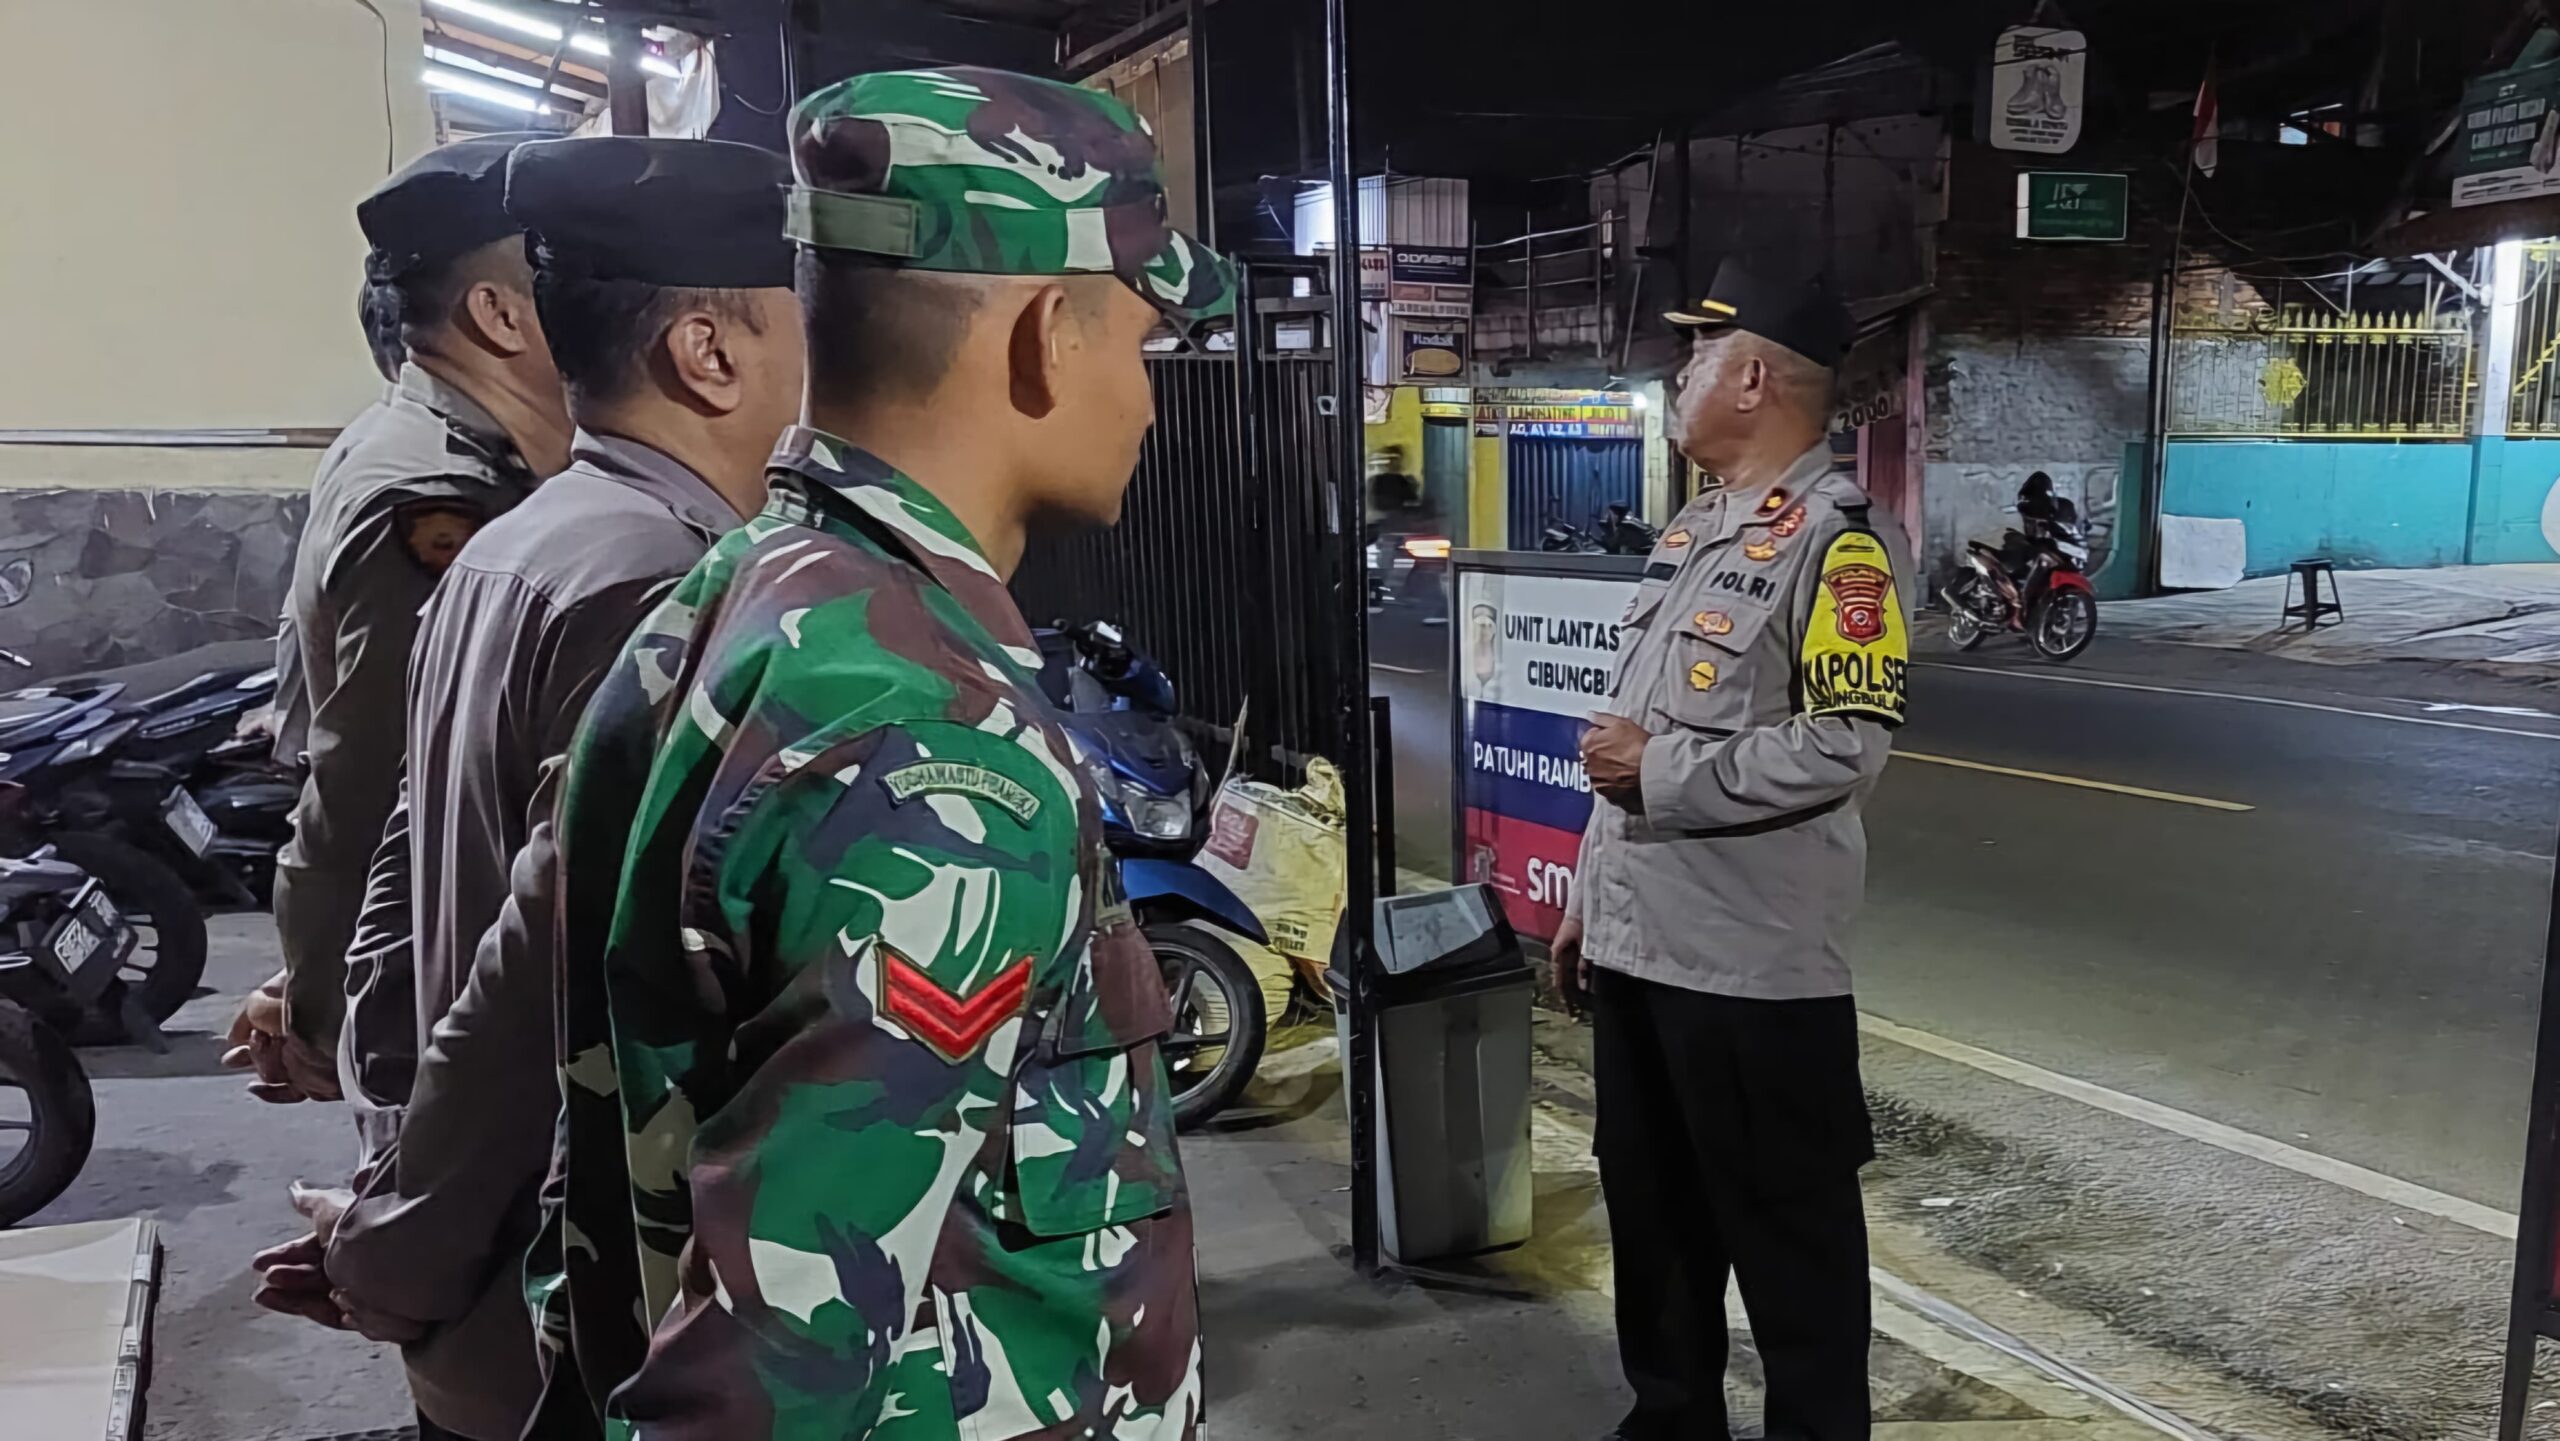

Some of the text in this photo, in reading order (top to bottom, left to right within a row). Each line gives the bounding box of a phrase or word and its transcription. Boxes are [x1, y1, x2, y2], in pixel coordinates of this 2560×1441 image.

[1505, 614, 1620, 652] UNIT LANTAS
[1474, 741, 1534, 781] PATUHI
